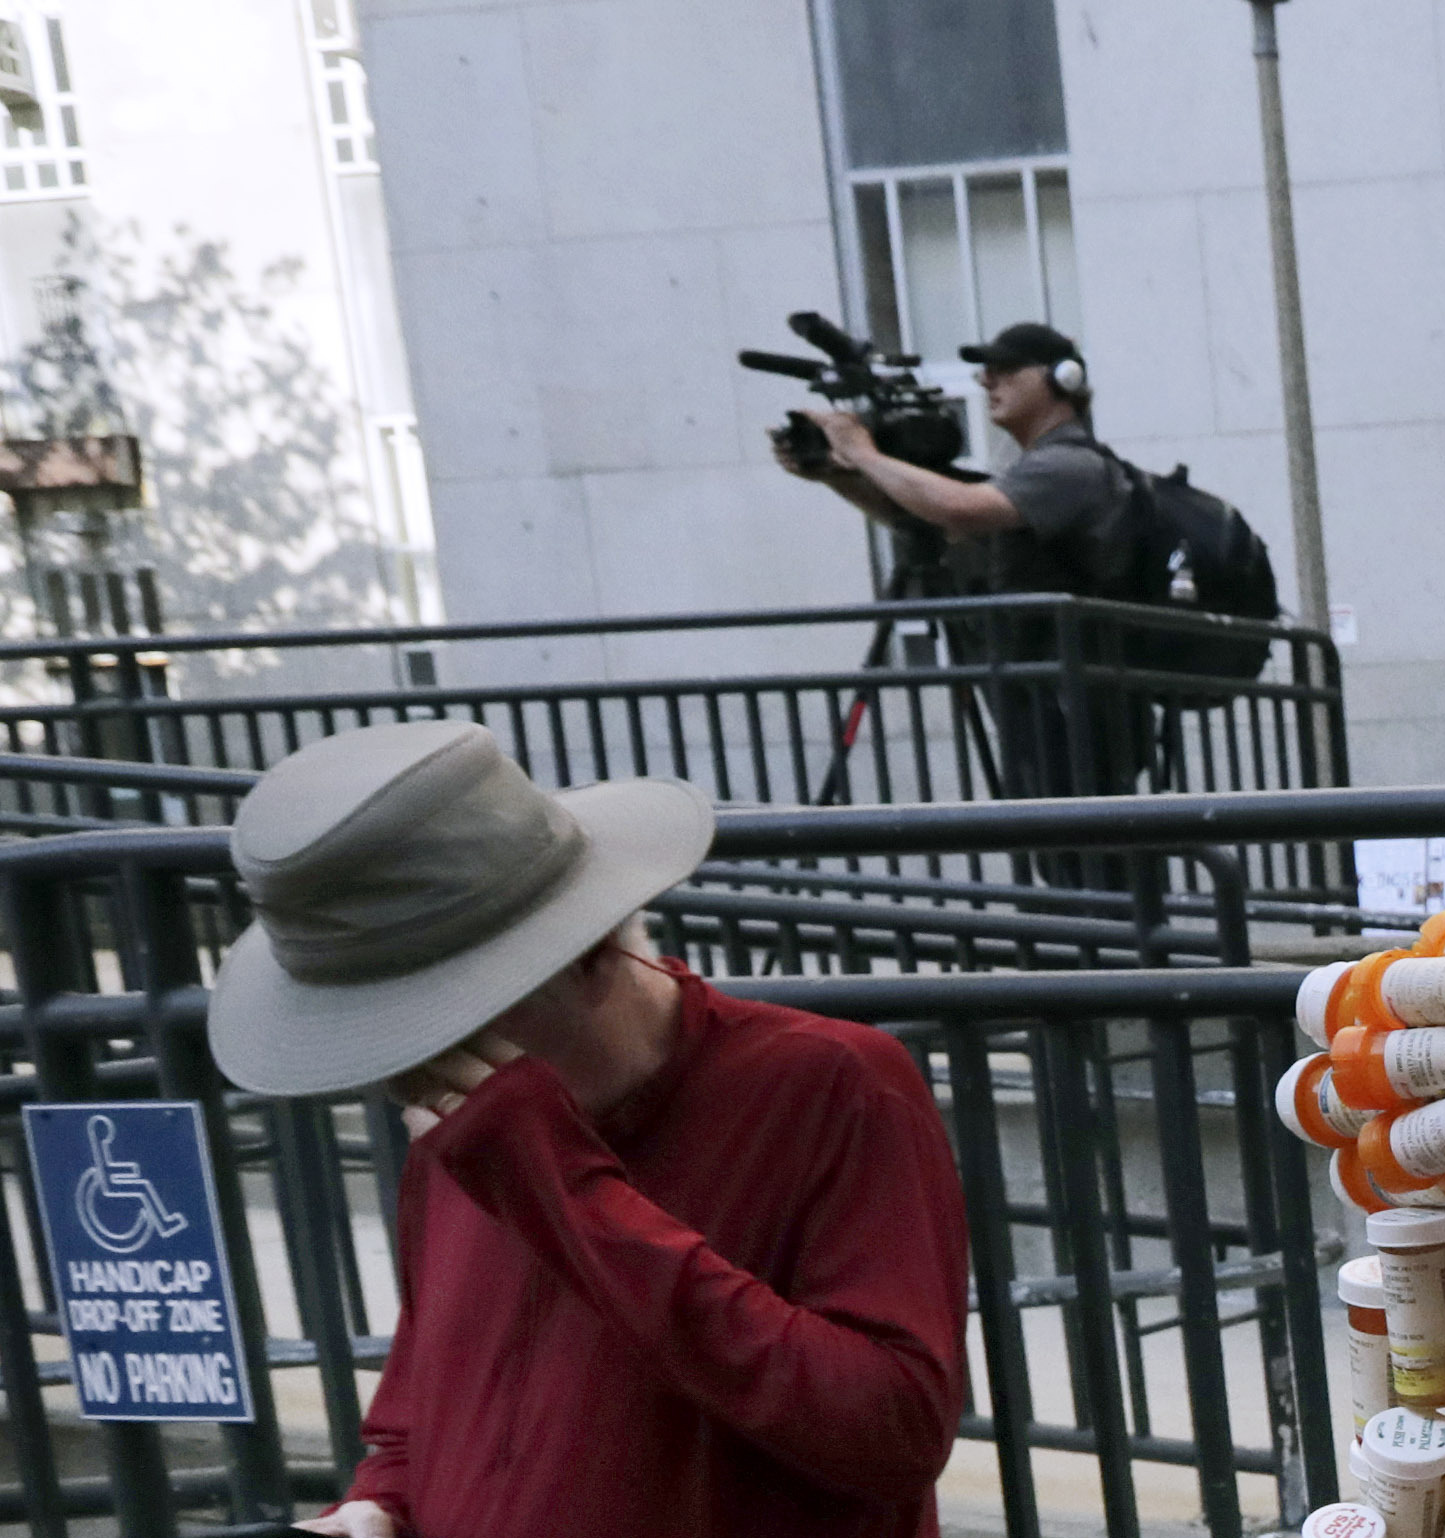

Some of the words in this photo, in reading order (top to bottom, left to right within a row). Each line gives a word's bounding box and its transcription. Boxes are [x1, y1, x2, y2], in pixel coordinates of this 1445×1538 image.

[68, 1260, 211, 1294] HANDICAP
[68, 1299, 161, 1332] DROP-OFF
[165, 1299, 225, 1332] ZONE
[79, 1351, 120, 1404] NO
[124, 1353, 238, 1404] PARKING
[1324, 1514, 1349, 1535] CVS
